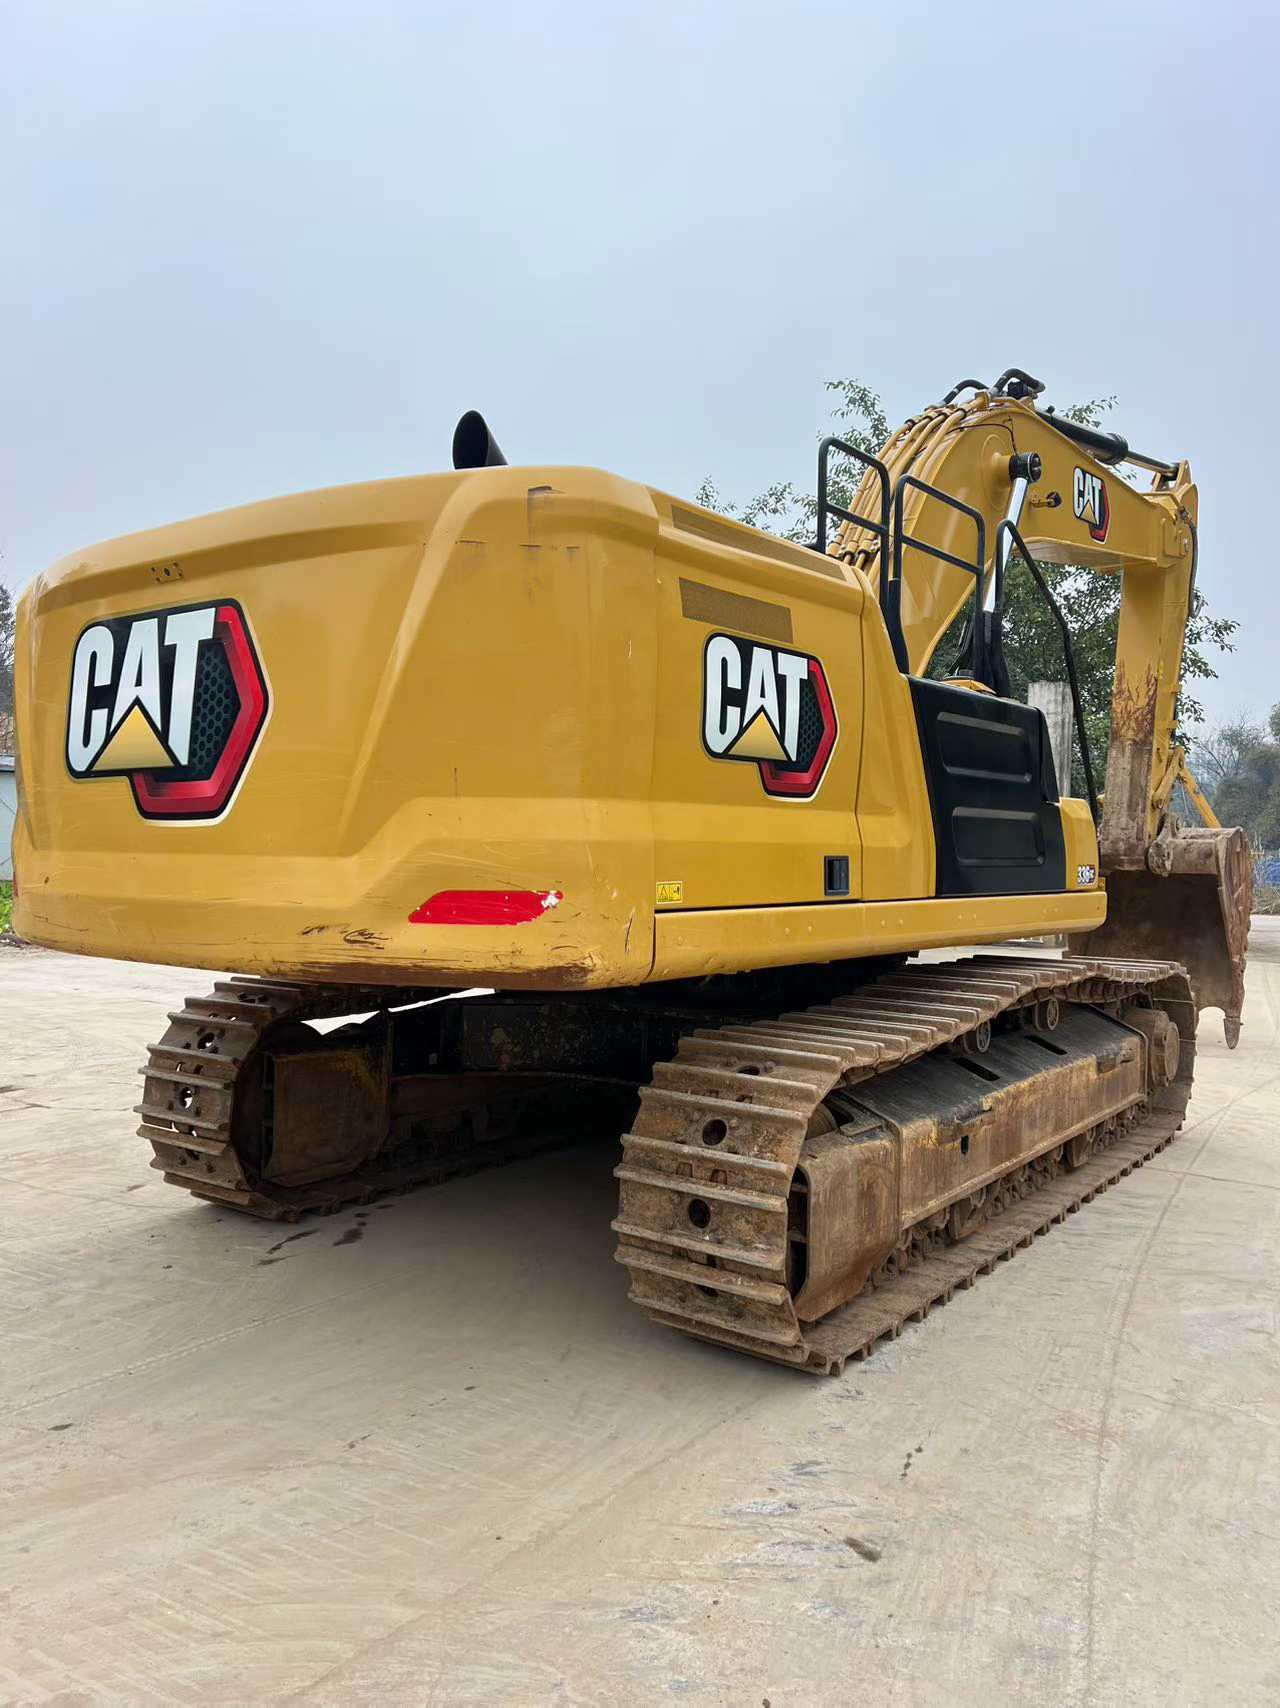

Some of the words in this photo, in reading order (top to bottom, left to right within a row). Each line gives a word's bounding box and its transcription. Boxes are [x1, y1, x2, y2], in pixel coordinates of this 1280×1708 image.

[1074, 467, 1102, 525] CAT
[68, 607, 216, 772] CAT
[705, 636, 808, 762] CAT
